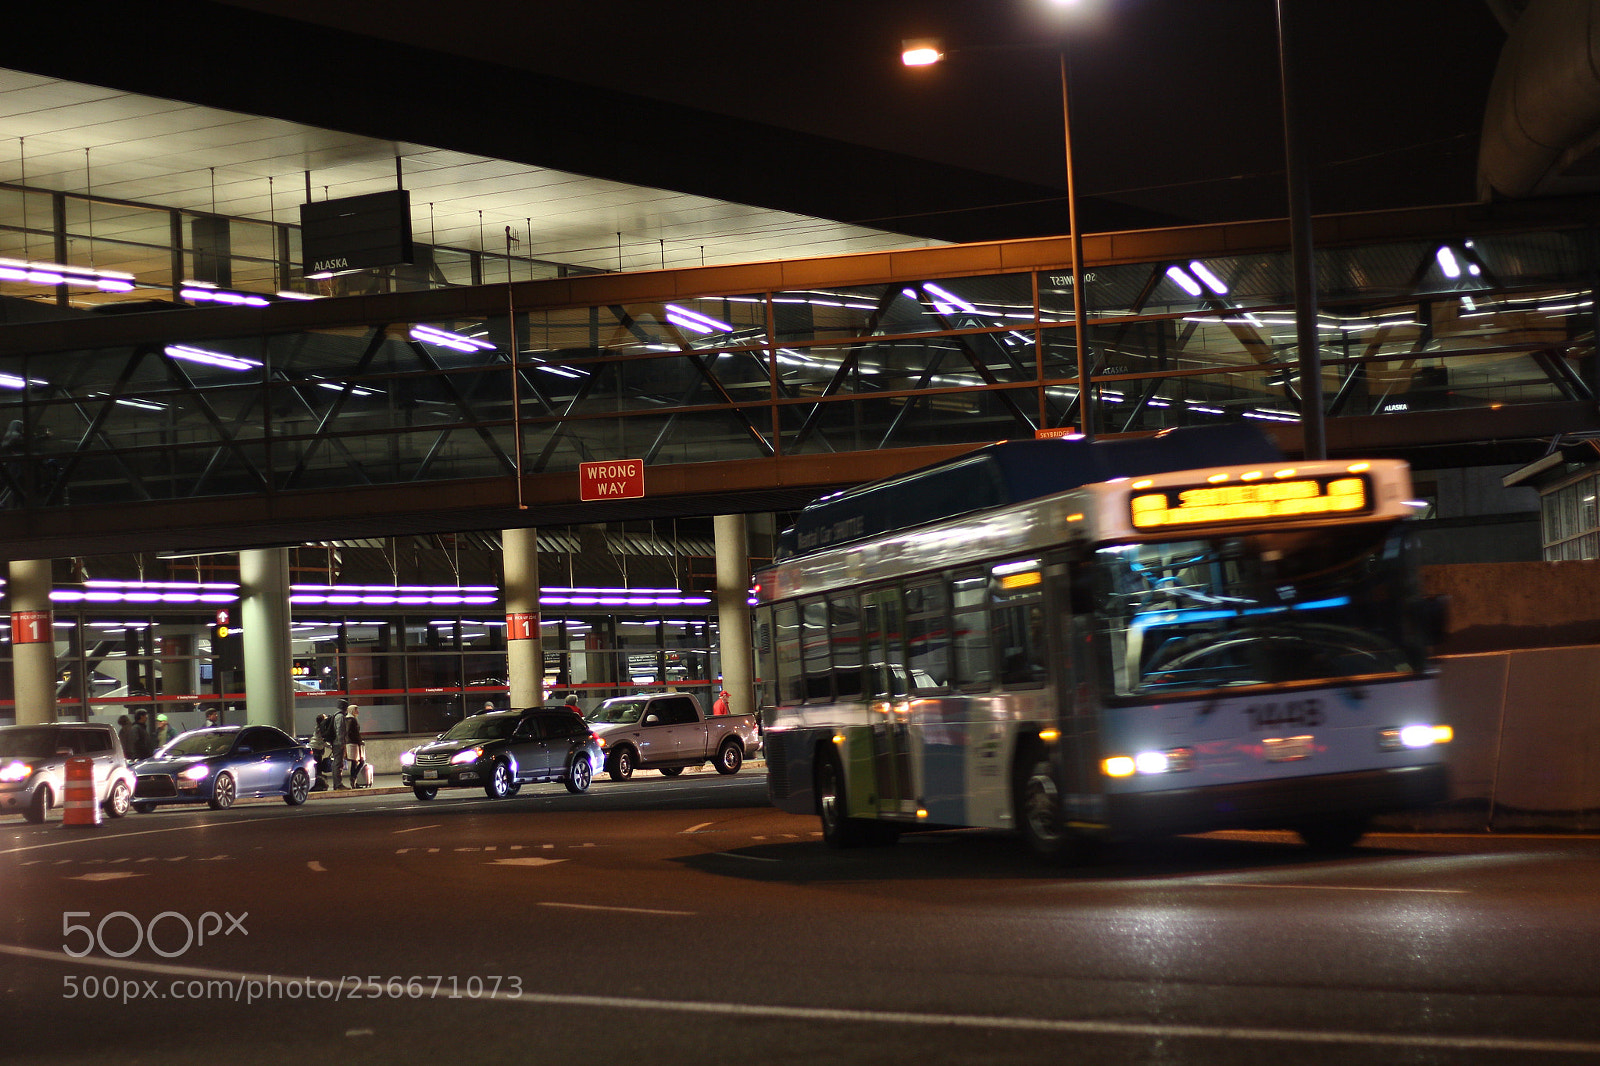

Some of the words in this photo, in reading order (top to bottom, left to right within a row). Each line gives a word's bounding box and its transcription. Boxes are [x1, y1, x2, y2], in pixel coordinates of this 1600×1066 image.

[314, 258, 348, 271] ALASKA
[1384, 403, 1408, 411] ALASKA
[587, 464, 636, 479] WRONG
[598, 481, 627, 495] WAY
[29, 621, 38, 640] 1
[522, 620, 530, 637] 1
